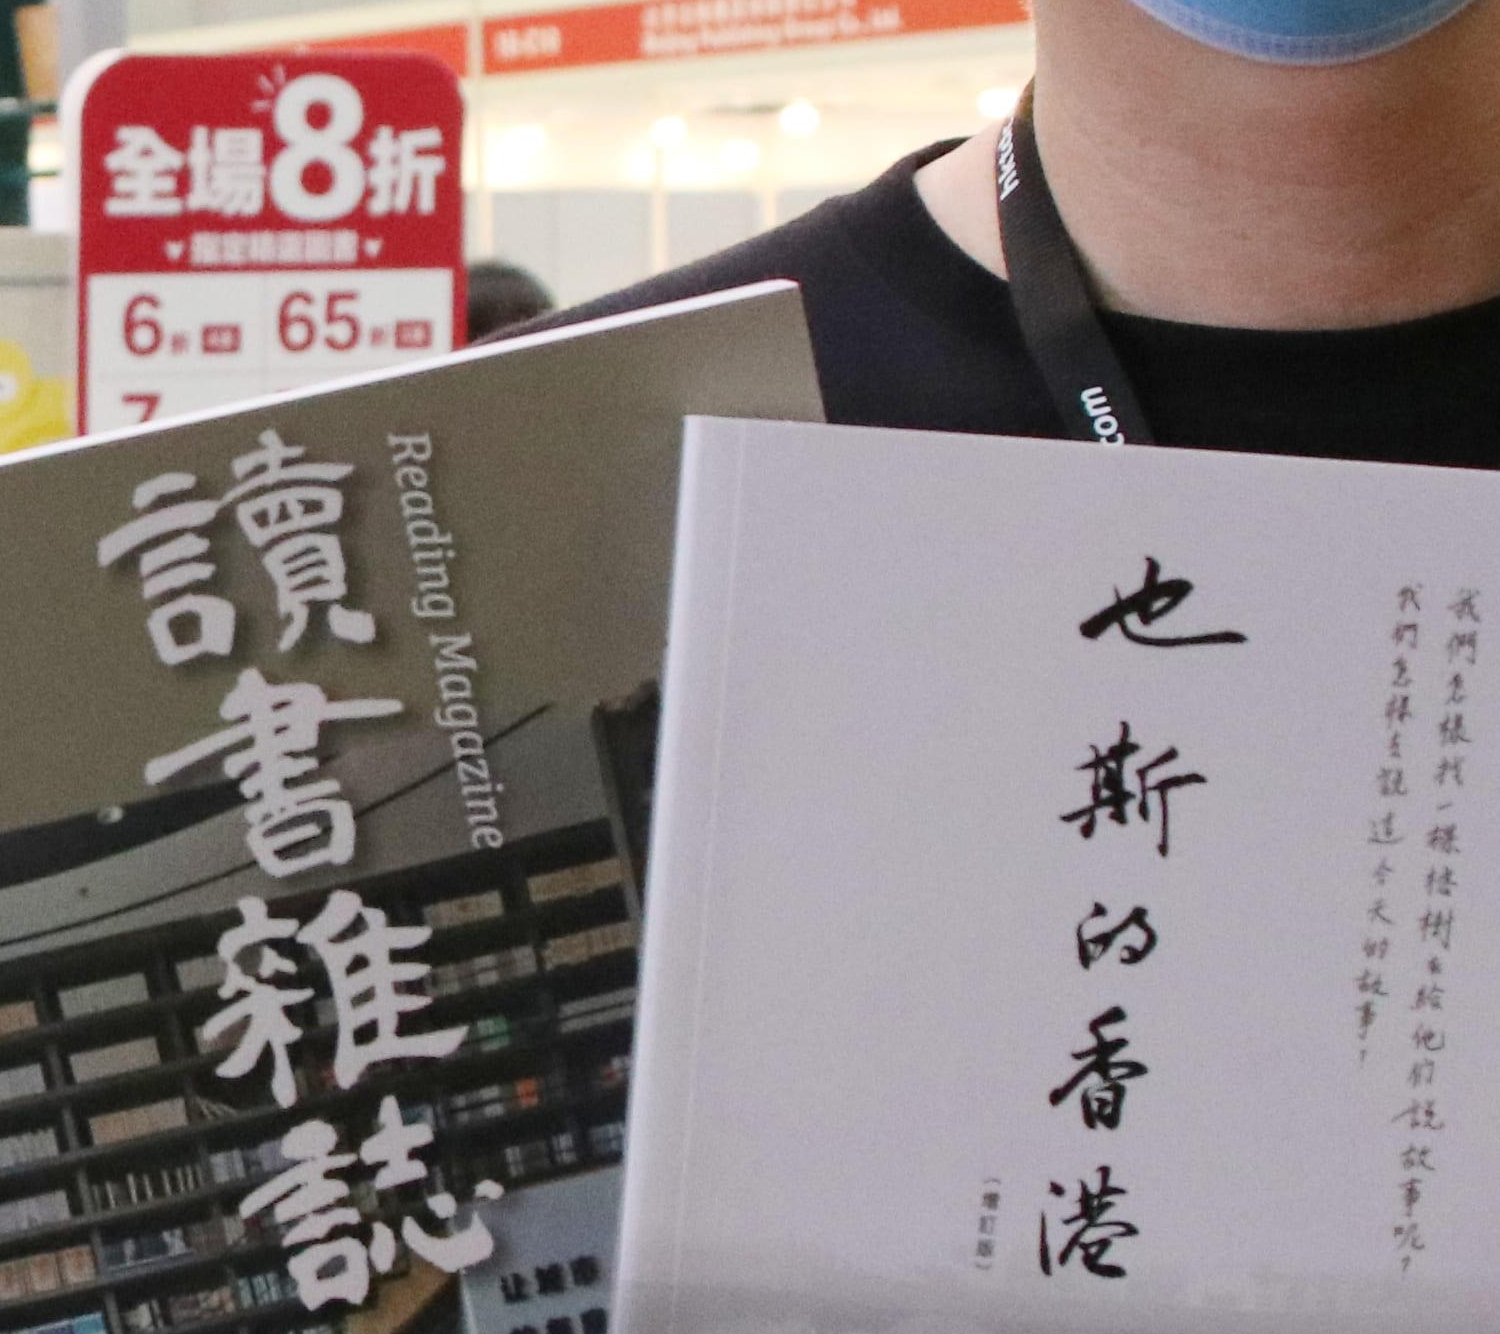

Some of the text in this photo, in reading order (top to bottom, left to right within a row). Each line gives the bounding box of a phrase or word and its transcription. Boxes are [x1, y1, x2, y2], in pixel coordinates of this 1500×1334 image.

[103, 70, 446, 223] 全場8折
[97, 429, 505, 1310] 讀書雜誌
[387, 431, 458, 620] Reading
[428, 631, 505, 850] Magazine
[1036, 554, 1249, 1280] 也斯的香港
